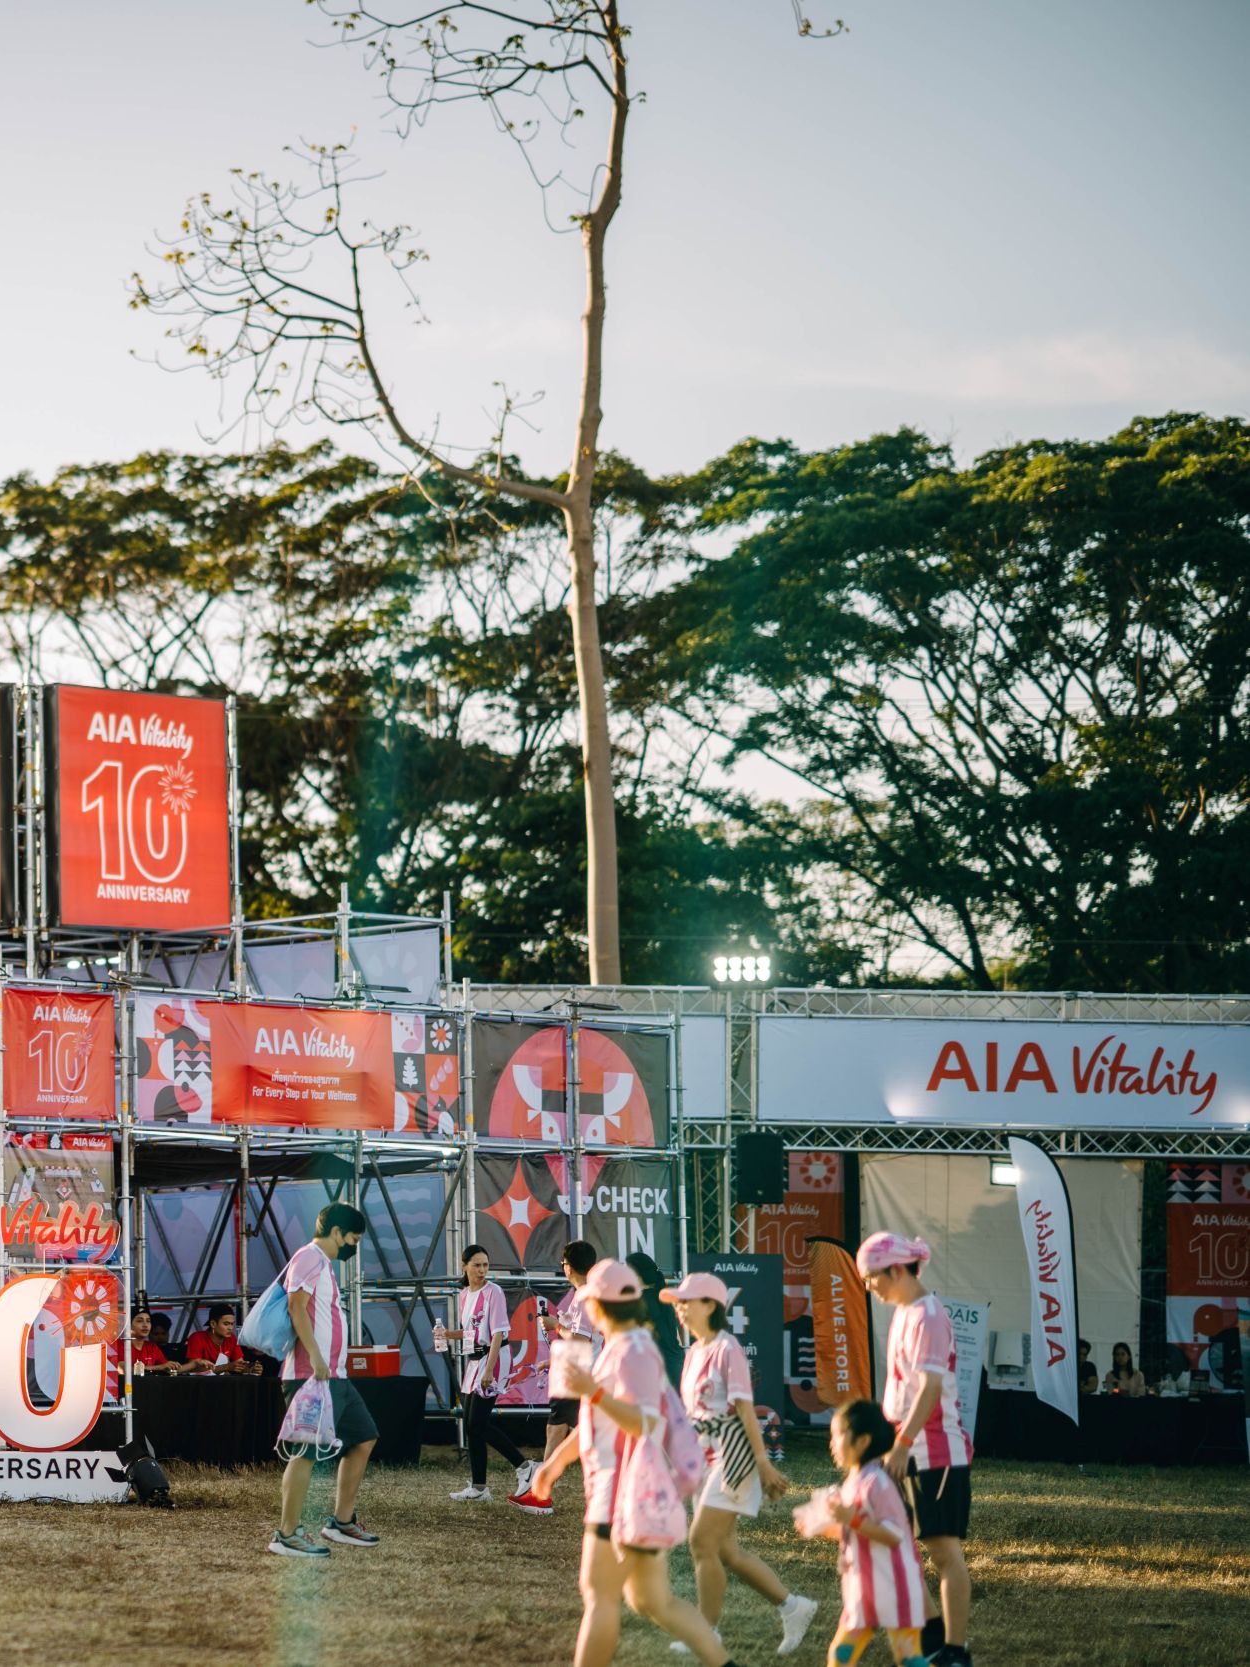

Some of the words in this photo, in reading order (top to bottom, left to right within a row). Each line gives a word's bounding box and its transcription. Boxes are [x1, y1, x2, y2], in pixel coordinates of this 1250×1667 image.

[87, 712, 137, 746] AIA
[139, 714, 194, 760] Vitality
[81, 760, 188, 884] 10
[96, 883, 190, 905] ANNIVERSARY
[32, 1005, 61, 1022] AIA
[62, 1005, 92, 1028] Vitality
[28, 1030, 89, 1094] 10
[254, 1027, 300, 1056] AIA
[303, 1026, 355, 1068] Vitality
[926, 1040, 1058, 1093] AIA
[1072, 1035, 1218, 1115] Vitality
[36, 1093, 89, 1105] ANNIVERSARY
[252, 1086, 263, 1097] For
[265, 1086, 284, 1100] Every
[285, 1087, 300, 1100] Step
[301, 1088, 308, 1099] of
[310, 1089, 325, 1100] Your
[327, 1090, 357, 1101] Wellness
[72, 1137, 88, 1147] AIA
[596, 1185, 669, 1215] CHECK
[760, 1203, 787, 1215] AIA
[789, 1202, 820, 1217] Vitality
[0, 1197, 116, 1263] Vitality
[1192, 1214, 1220, 1227] AIA
[617, 1216, 656, 1264] IN
[1190, 1232, 1249, 1279] 10
[714, 1263, 735, 1272] AIA
[735, 1263, 759, 1275] Vitality
[829, 1273, 850, 1393] ALIVE.STORE
